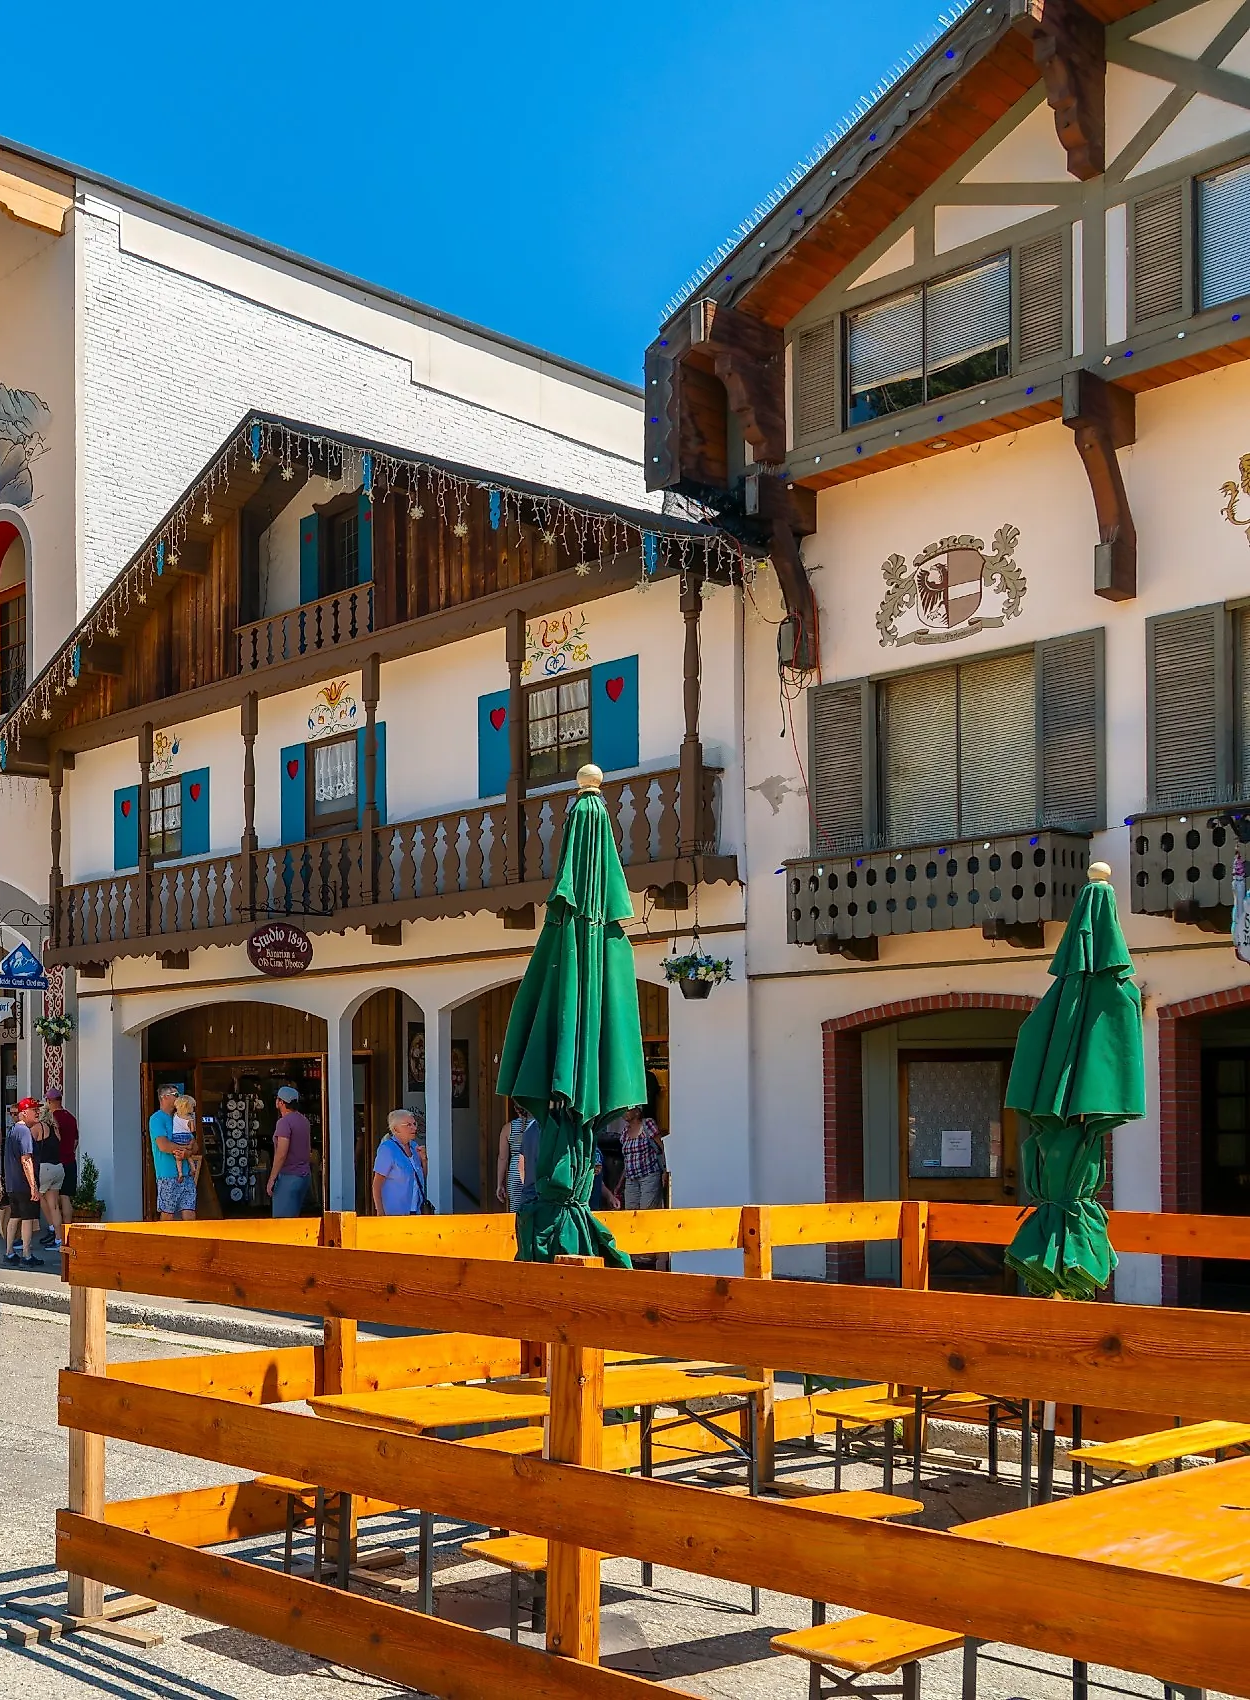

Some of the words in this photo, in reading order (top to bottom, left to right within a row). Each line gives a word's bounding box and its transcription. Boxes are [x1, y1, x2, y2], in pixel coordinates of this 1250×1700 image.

[252, 926, 285, 953] Studio
[288, 930, 308, 953] 1890
[257, 957, 270, 967] Old
[270, 957, 284, 968] Time
[284, 958, 305, 970] Photos
